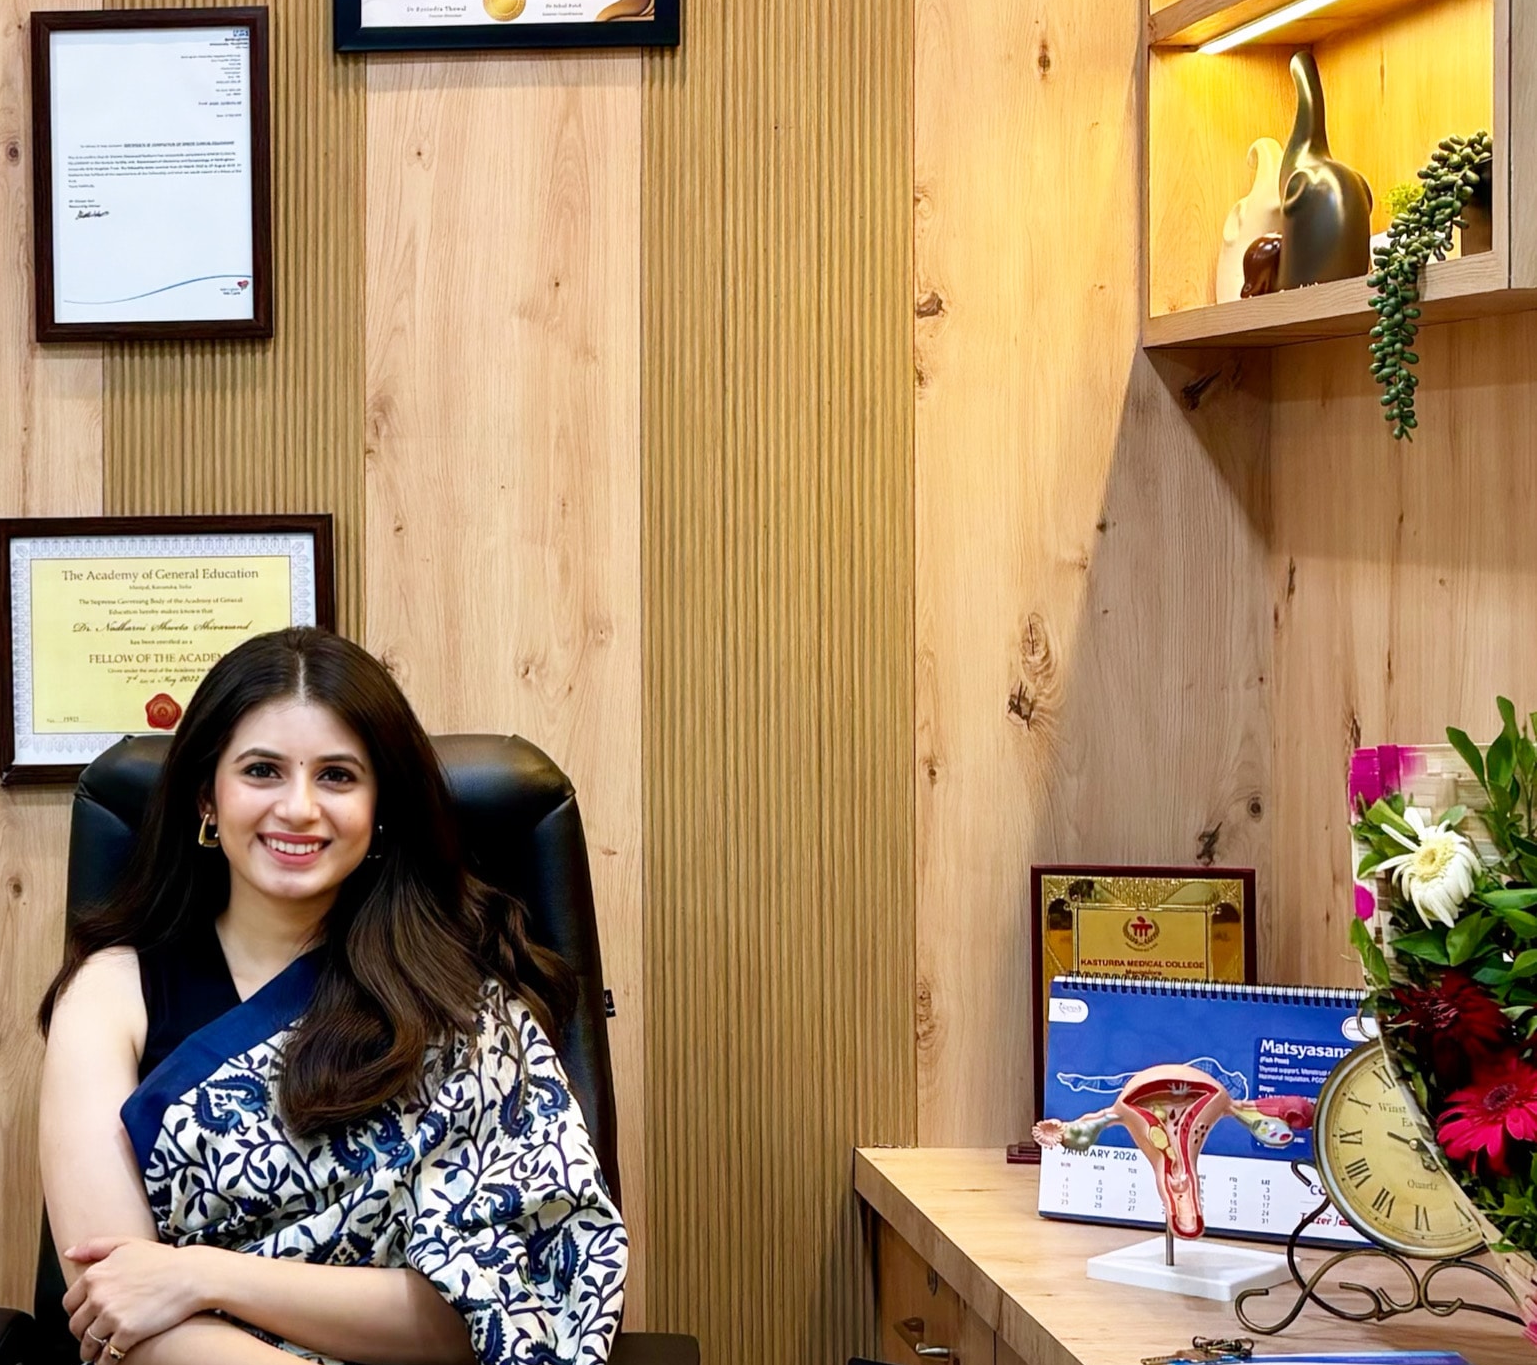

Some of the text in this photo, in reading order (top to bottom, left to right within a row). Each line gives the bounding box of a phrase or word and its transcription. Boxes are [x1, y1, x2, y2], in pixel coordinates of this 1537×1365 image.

[62, 569, 258, 582] The Academy of General Education
[89, 653, 223, 664] FELLOW OF THE ACADE
[1081, 959, 1125, 967] KASTURBA
[1378, 1102, 1406, 1113] Winst
[1339, 1128, 1362, 1145] IX
[1114, 1151, 1137, 1161] 2026
[1345, 1158, 1372, 1189] VIII
[1372, 1187, 1396, 1218] VII
[1414, 1205, 1430, 1231] VI
